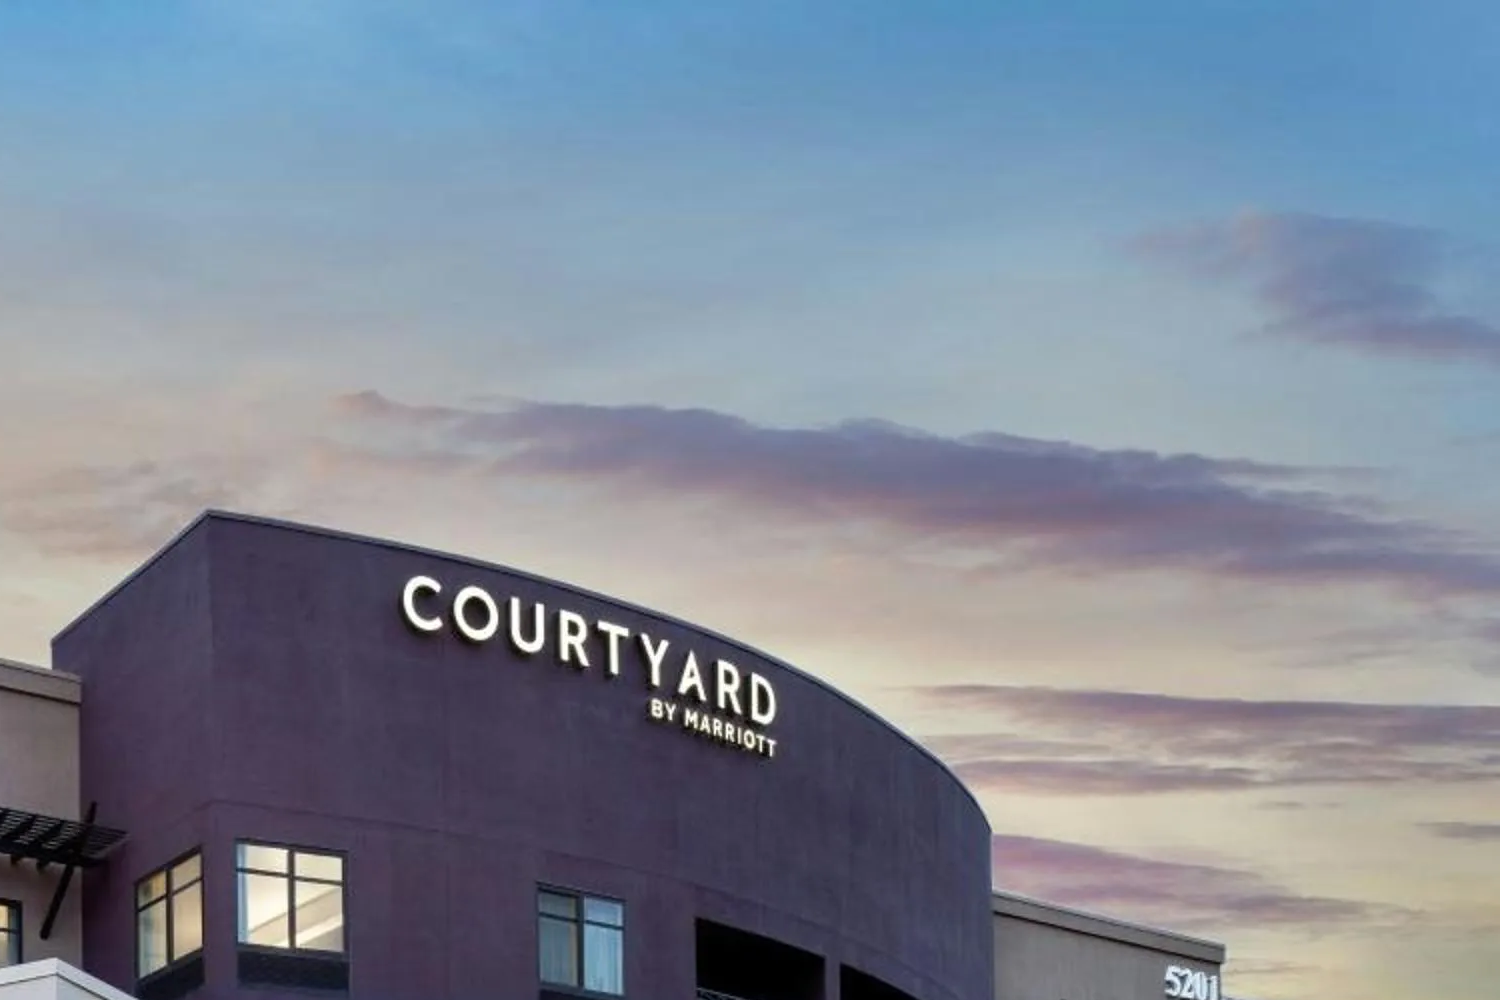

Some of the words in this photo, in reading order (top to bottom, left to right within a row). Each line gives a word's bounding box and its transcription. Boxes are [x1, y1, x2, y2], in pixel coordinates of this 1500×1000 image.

[402, 575, 777, 726] COURTYARD
[651, 698, 677, 721] BY
[685, 711, 778, 758] MARRIOTT
